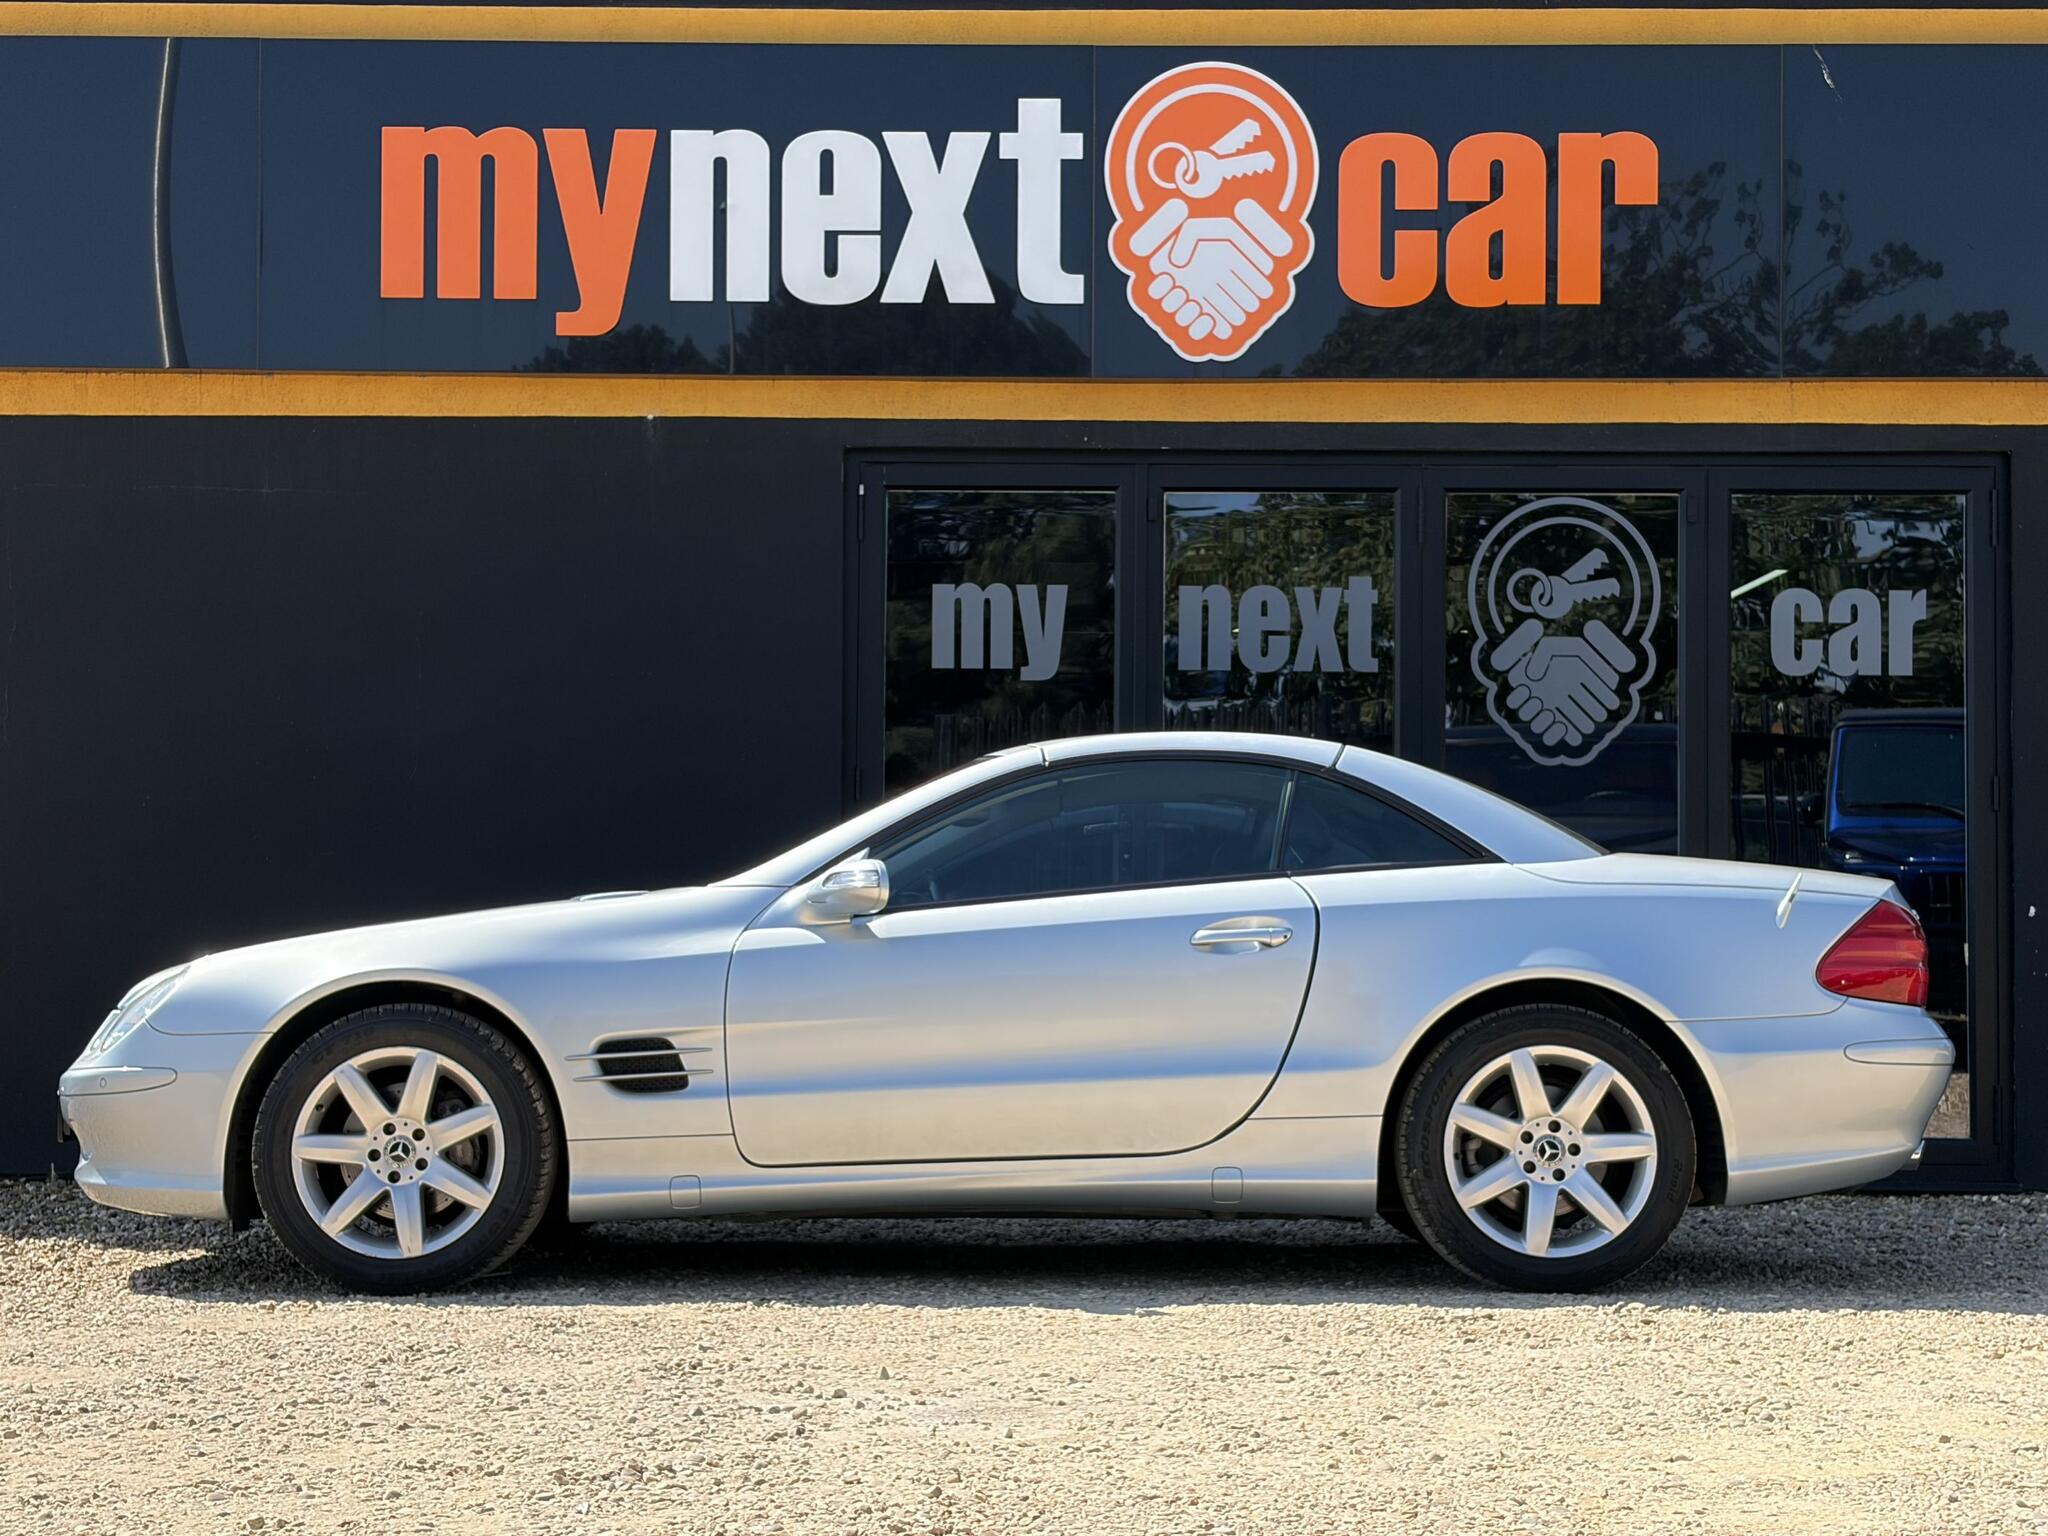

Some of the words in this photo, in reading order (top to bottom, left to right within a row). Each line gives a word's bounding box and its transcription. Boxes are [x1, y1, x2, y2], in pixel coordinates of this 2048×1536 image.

[1337, 131, 1659, 308] car
[931, 582, 1069, 681] my
[1178, 576, 1379, 673] next
[1770, 587, 1927, 677] car
